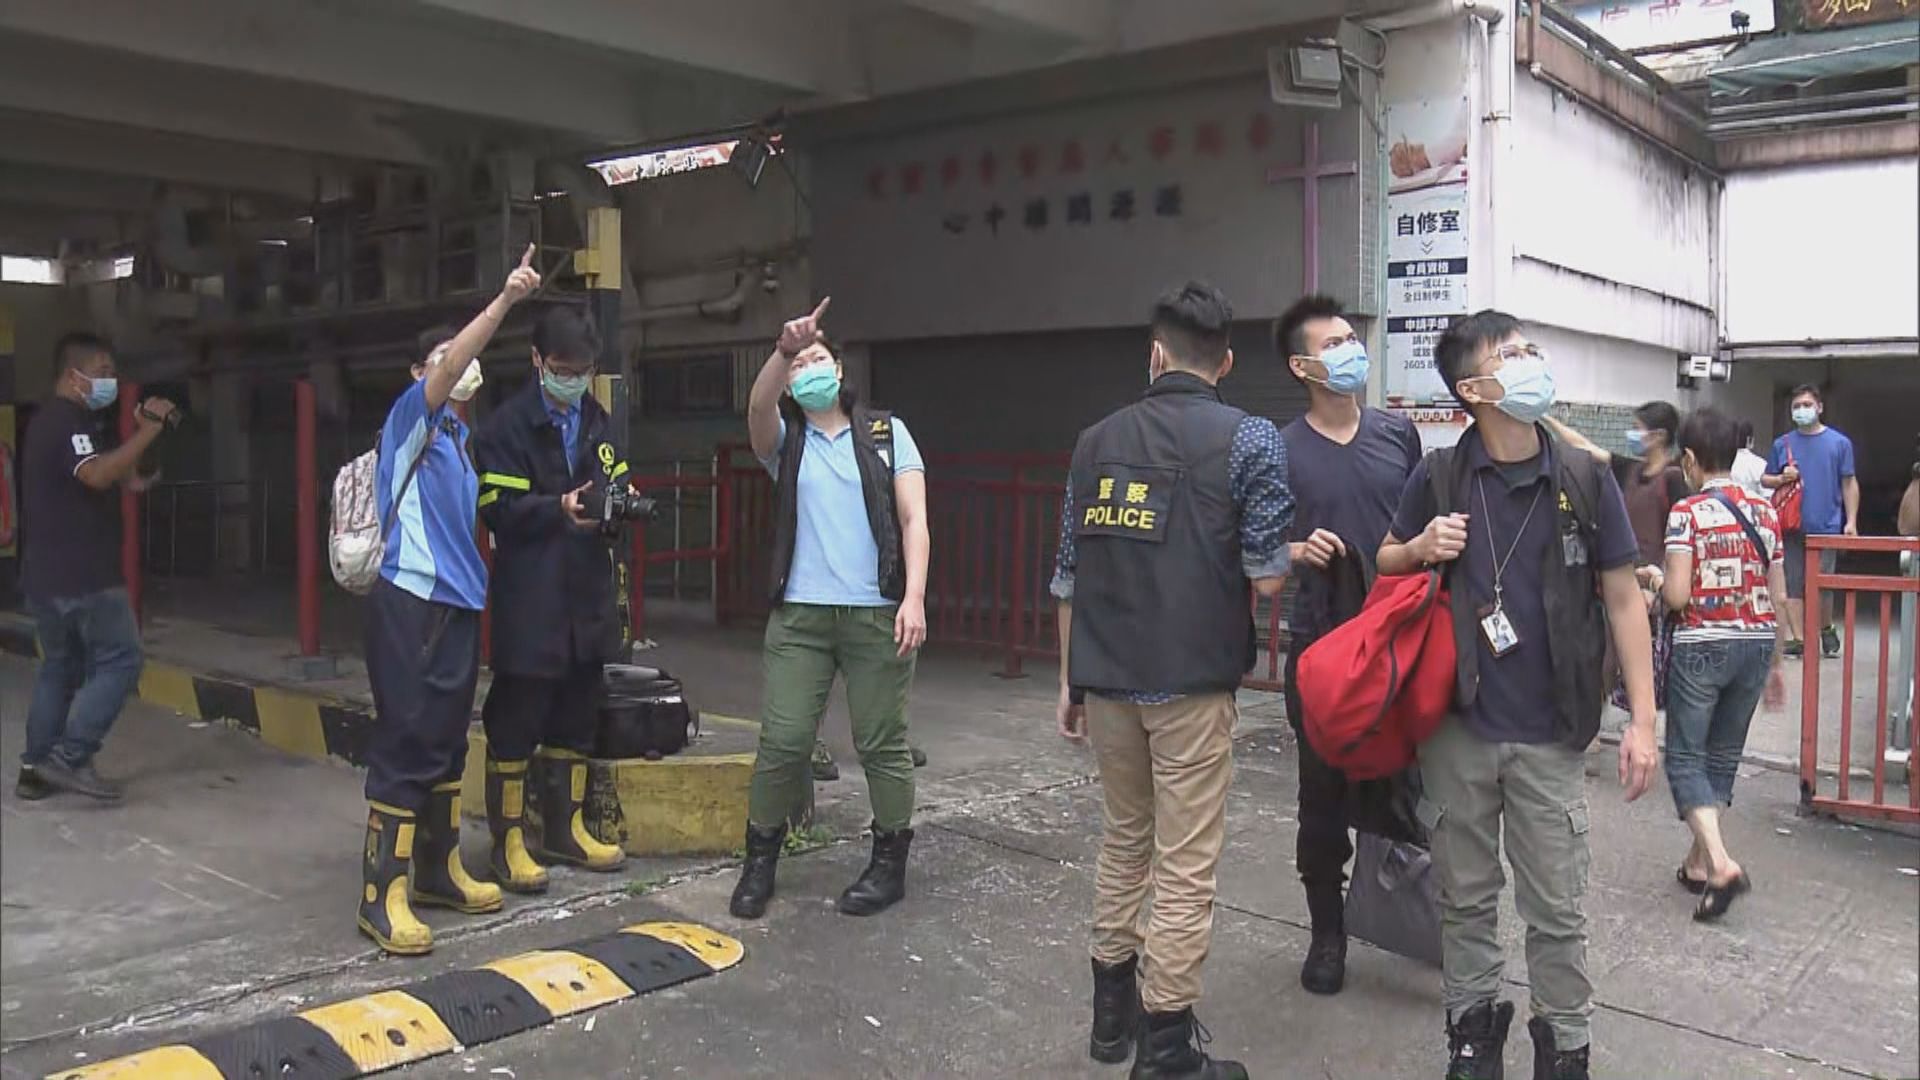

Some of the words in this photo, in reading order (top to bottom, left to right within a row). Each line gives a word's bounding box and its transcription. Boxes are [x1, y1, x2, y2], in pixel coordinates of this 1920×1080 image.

[1398, 210, 1460, 236] 自修室
[1403, 278, 1451, 290] 中一或以上
[1403, 290, 1451, 303] 全日制學生
[1098, 477, 1149, 503] 警察
[1084, 506, 1156, 529] POLICE
